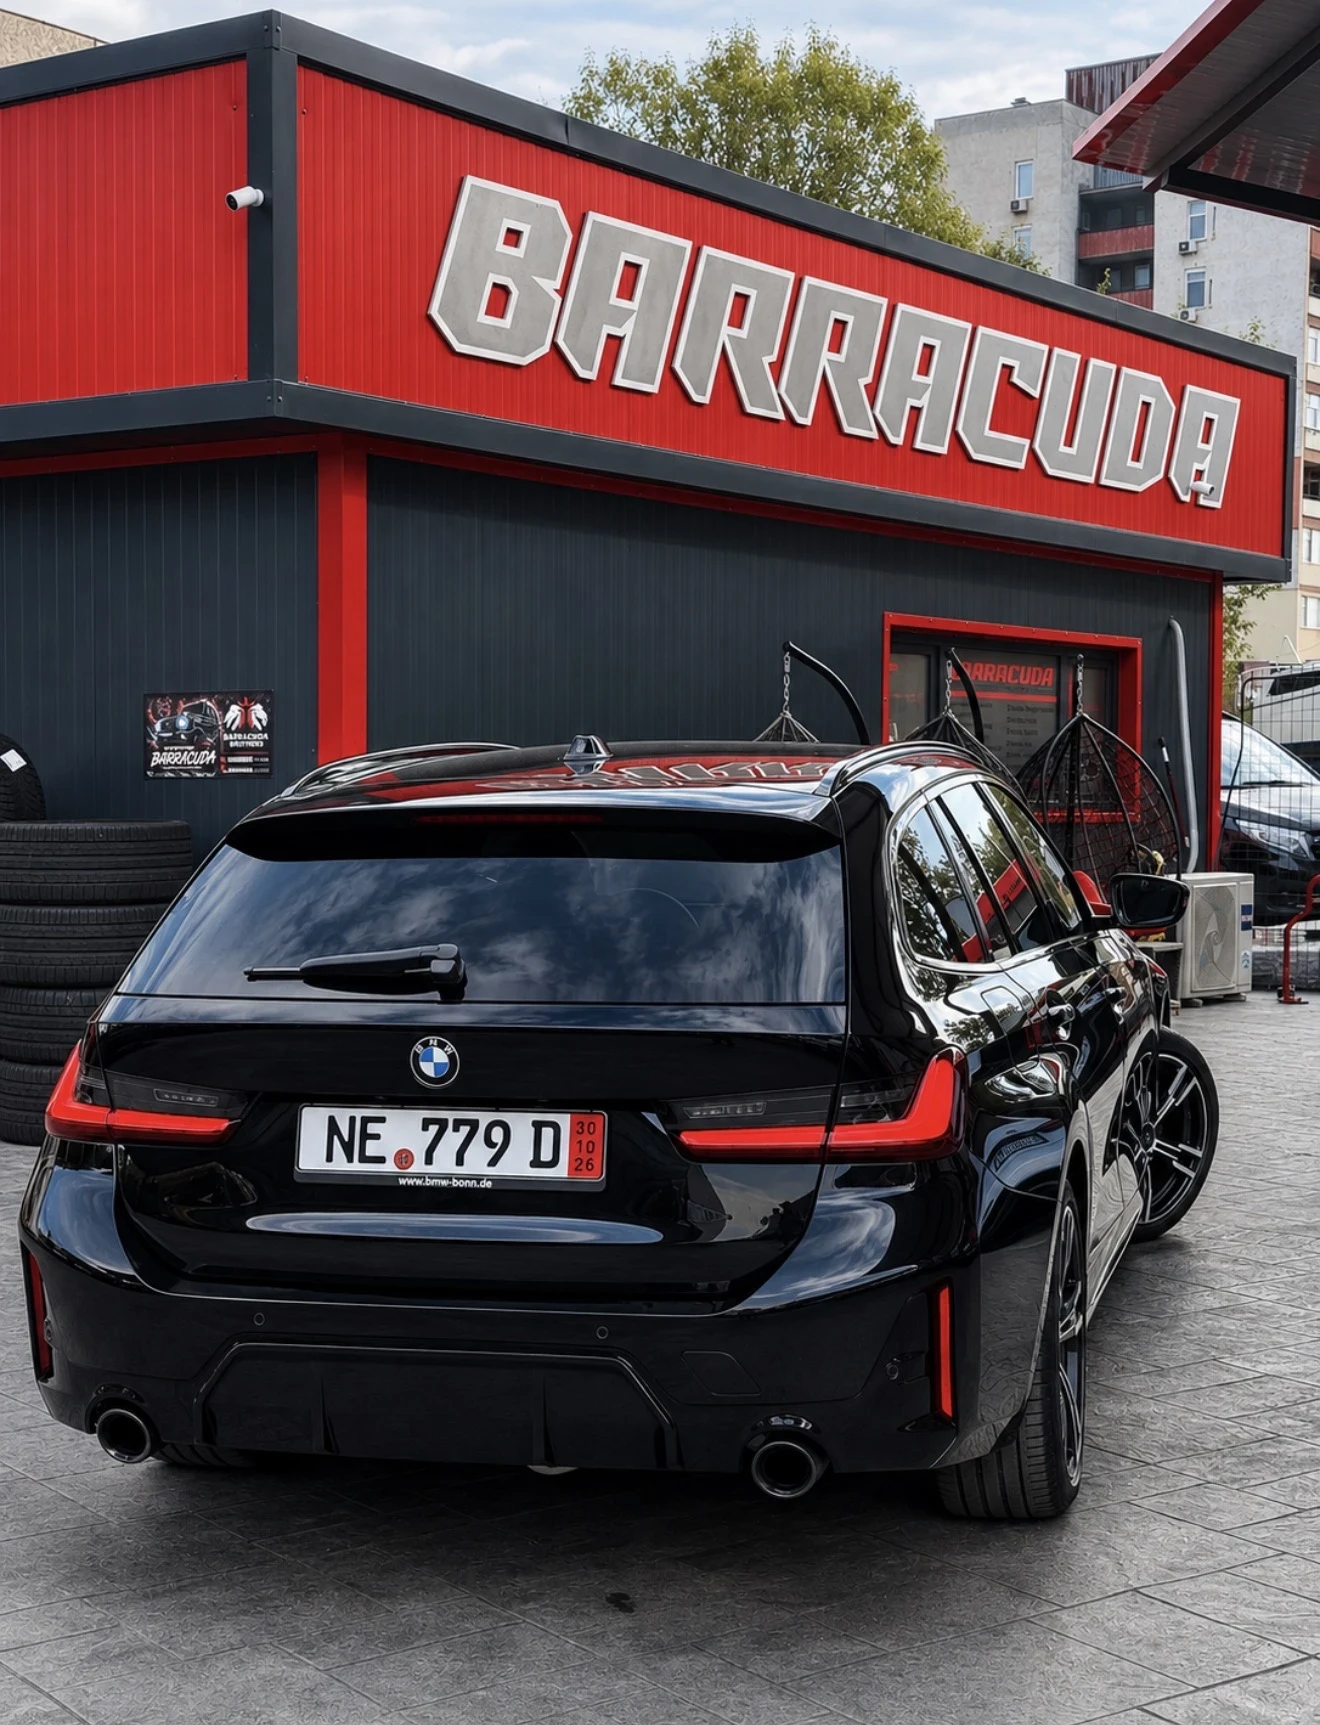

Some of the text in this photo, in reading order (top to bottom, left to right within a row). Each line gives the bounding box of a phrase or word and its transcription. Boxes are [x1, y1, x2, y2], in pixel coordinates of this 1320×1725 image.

[427, 174, 1242, 510] BARRACUDA
[150, 751, 217, 767] BARRACUDA
[415, 1038, 454, 1056] BMW
[576, 1121, 597, 1135] 30
[325, 1115, 562, 1169] NE 779 D
[576, 1140, 595, 1154] 10
[574, 1157, 595, 1172] 26
[398, 1175, 492, 1189] www.bmw-bonn.de
